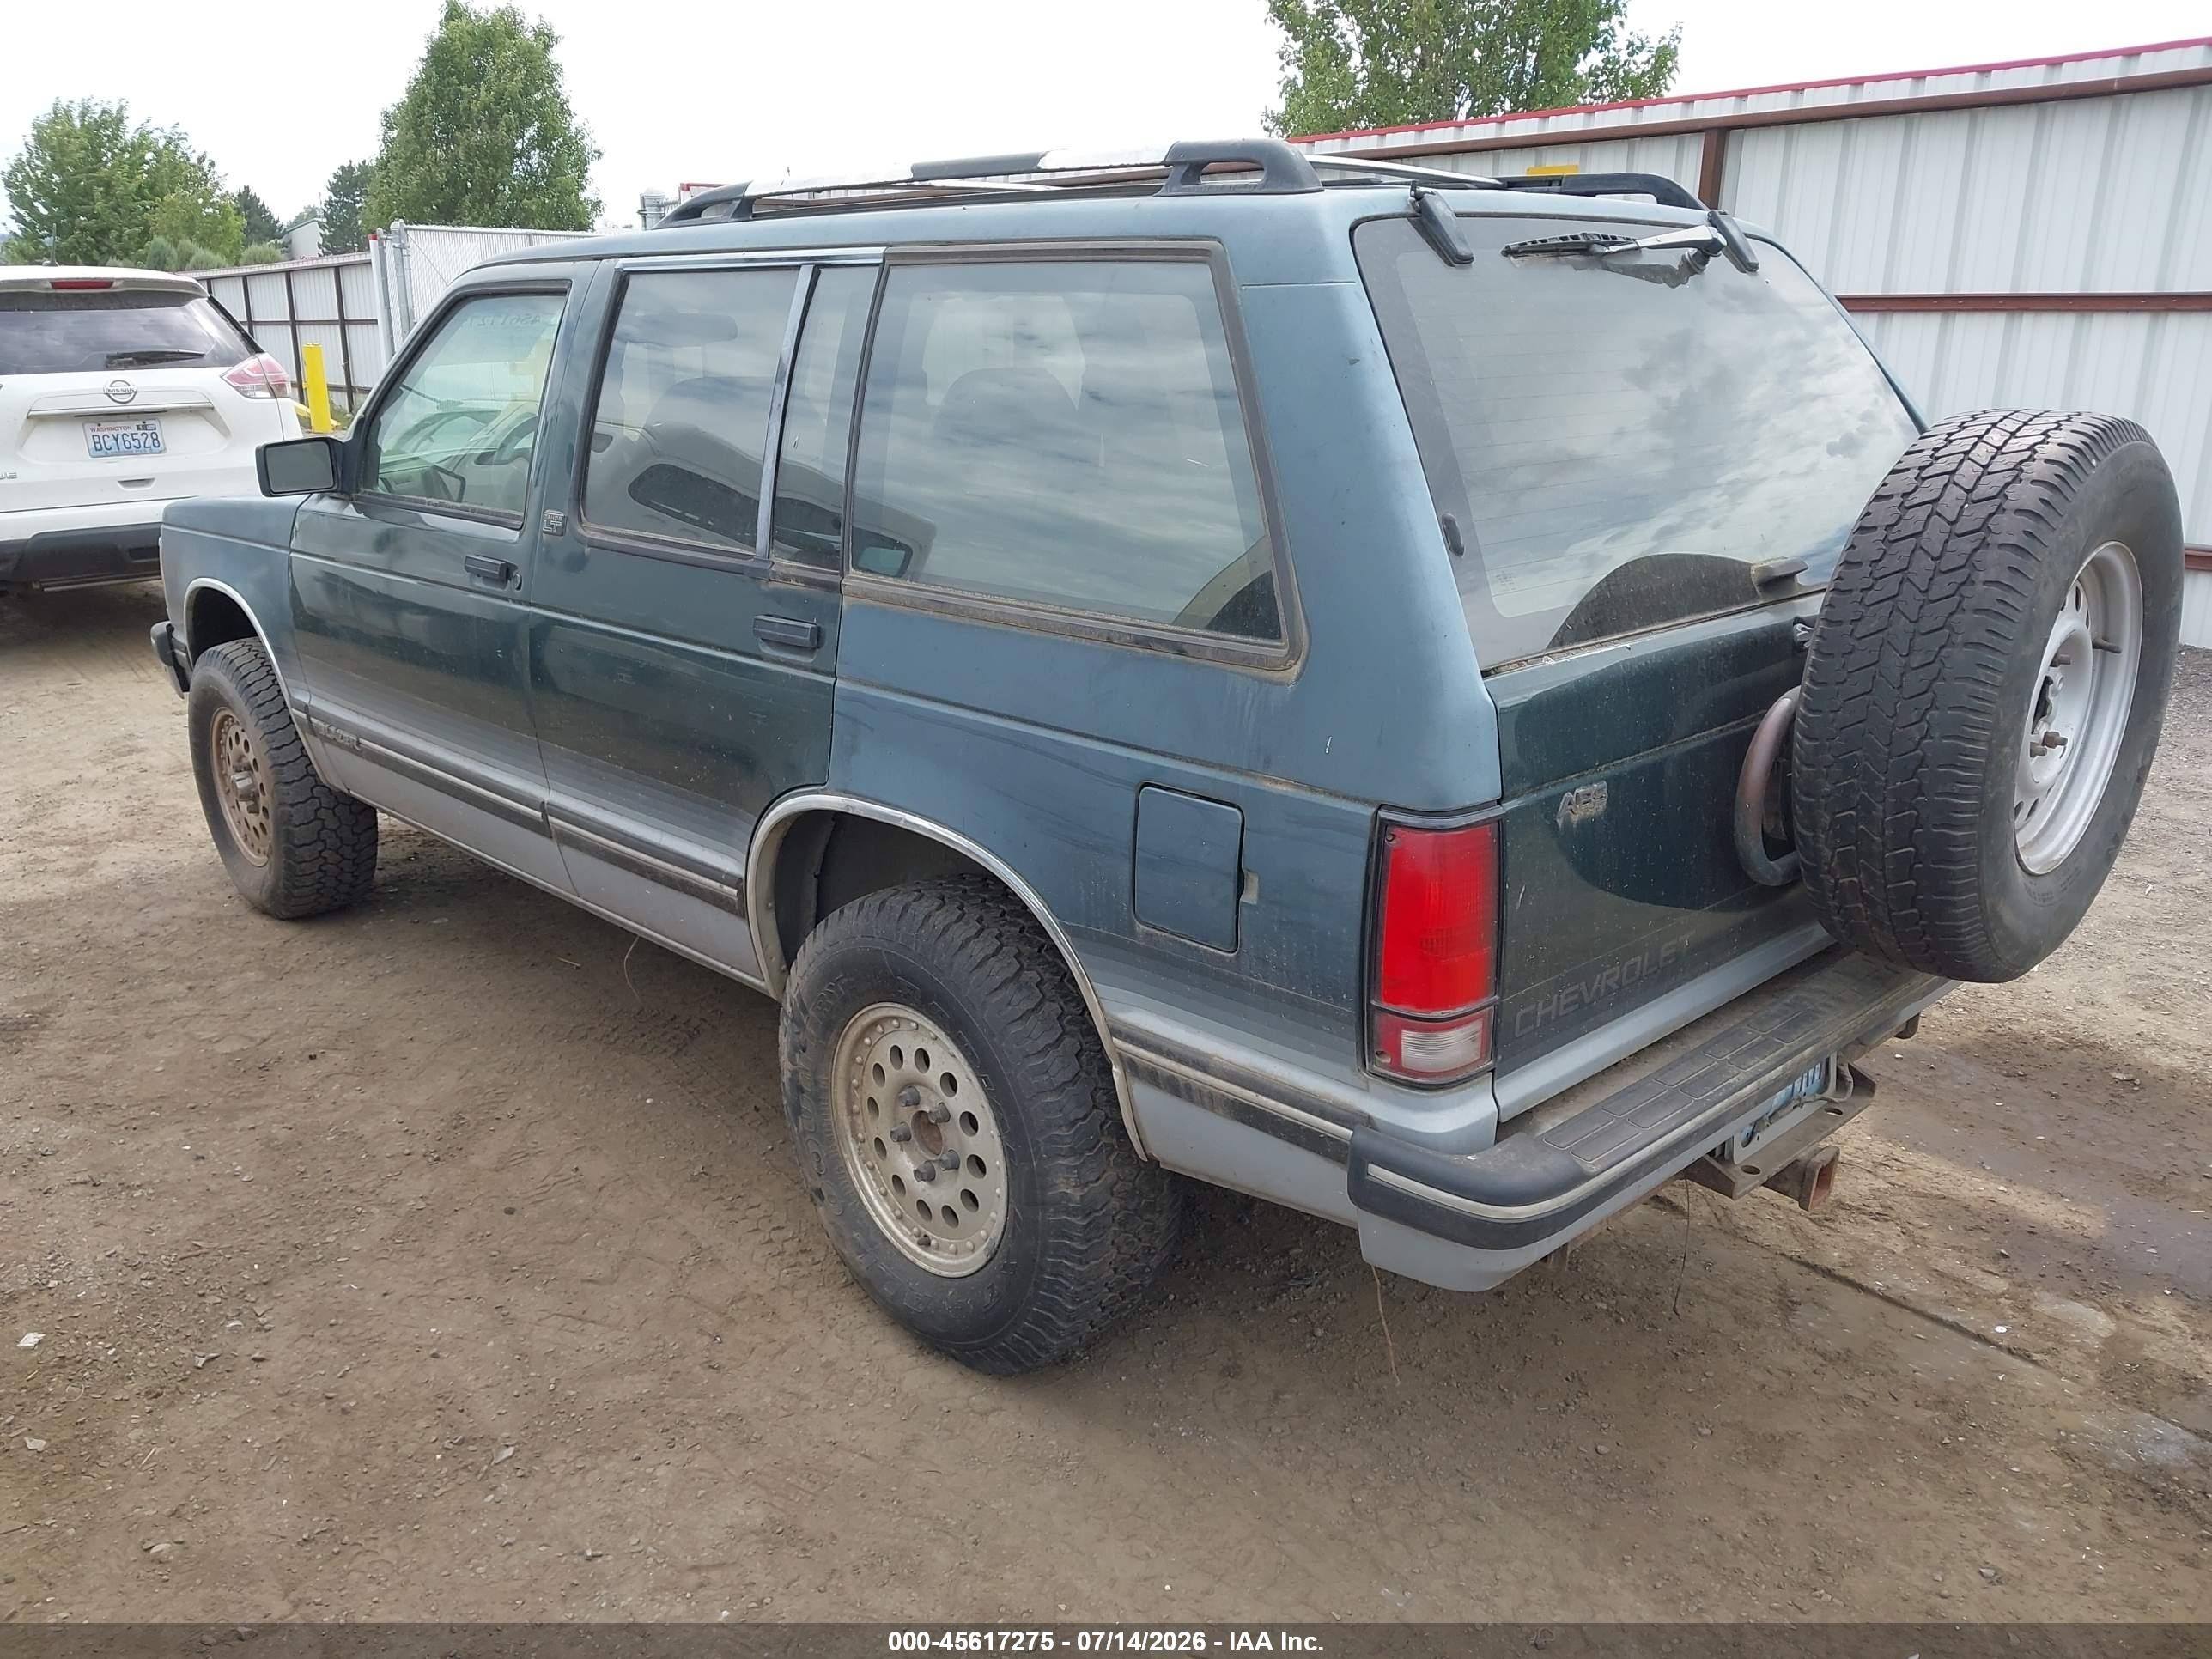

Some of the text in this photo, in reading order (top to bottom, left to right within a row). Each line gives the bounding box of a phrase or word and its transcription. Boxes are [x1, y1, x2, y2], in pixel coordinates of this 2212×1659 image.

[92, 432, 161, 452] BCY6528
[543, 520, 562, 533] LT
[1556, 781, 1607, 826] ABS
[1515, 929, 1697, 1038] CHEVROLET
